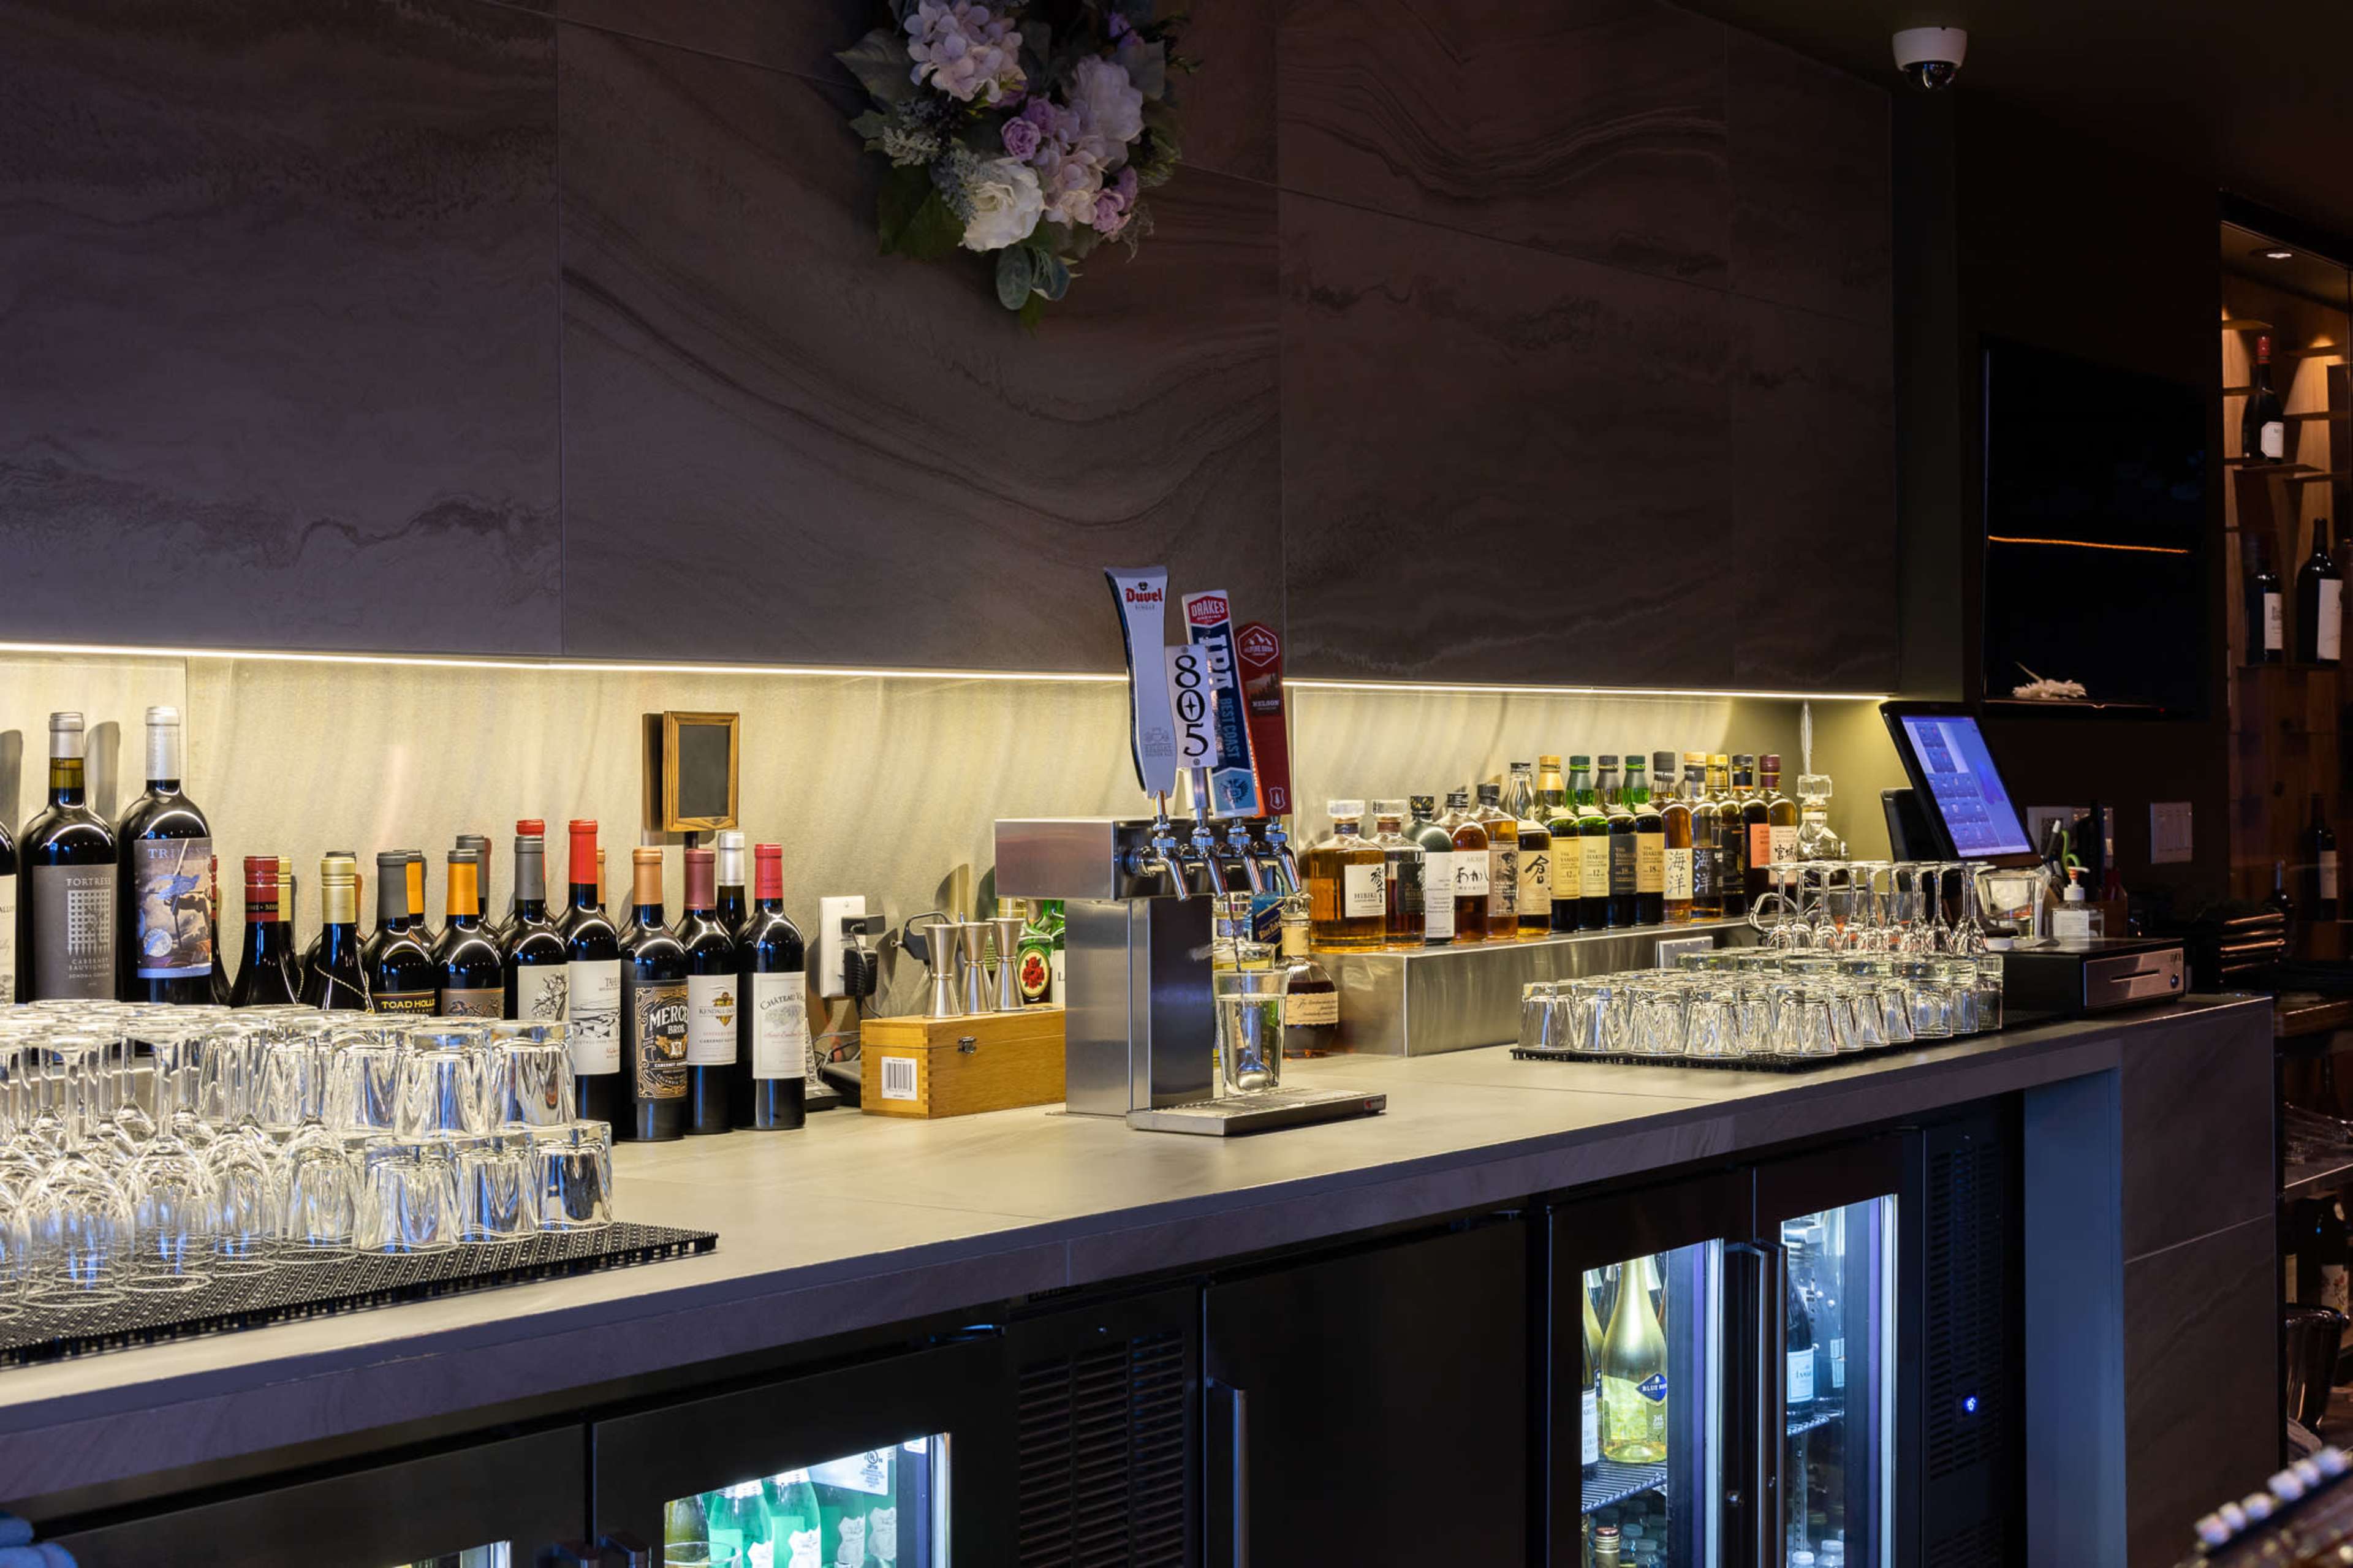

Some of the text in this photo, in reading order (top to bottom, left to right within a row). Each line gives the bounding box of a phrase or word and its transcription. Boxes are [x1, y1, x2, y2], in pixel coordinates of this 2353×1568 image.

[1125, 588, 1163, 602] Duvel
[1175, 654, 1209, 757] 805
[1223, 725, 1240, 759] COAST
[1667, 850, 1686, 896] 海洋
